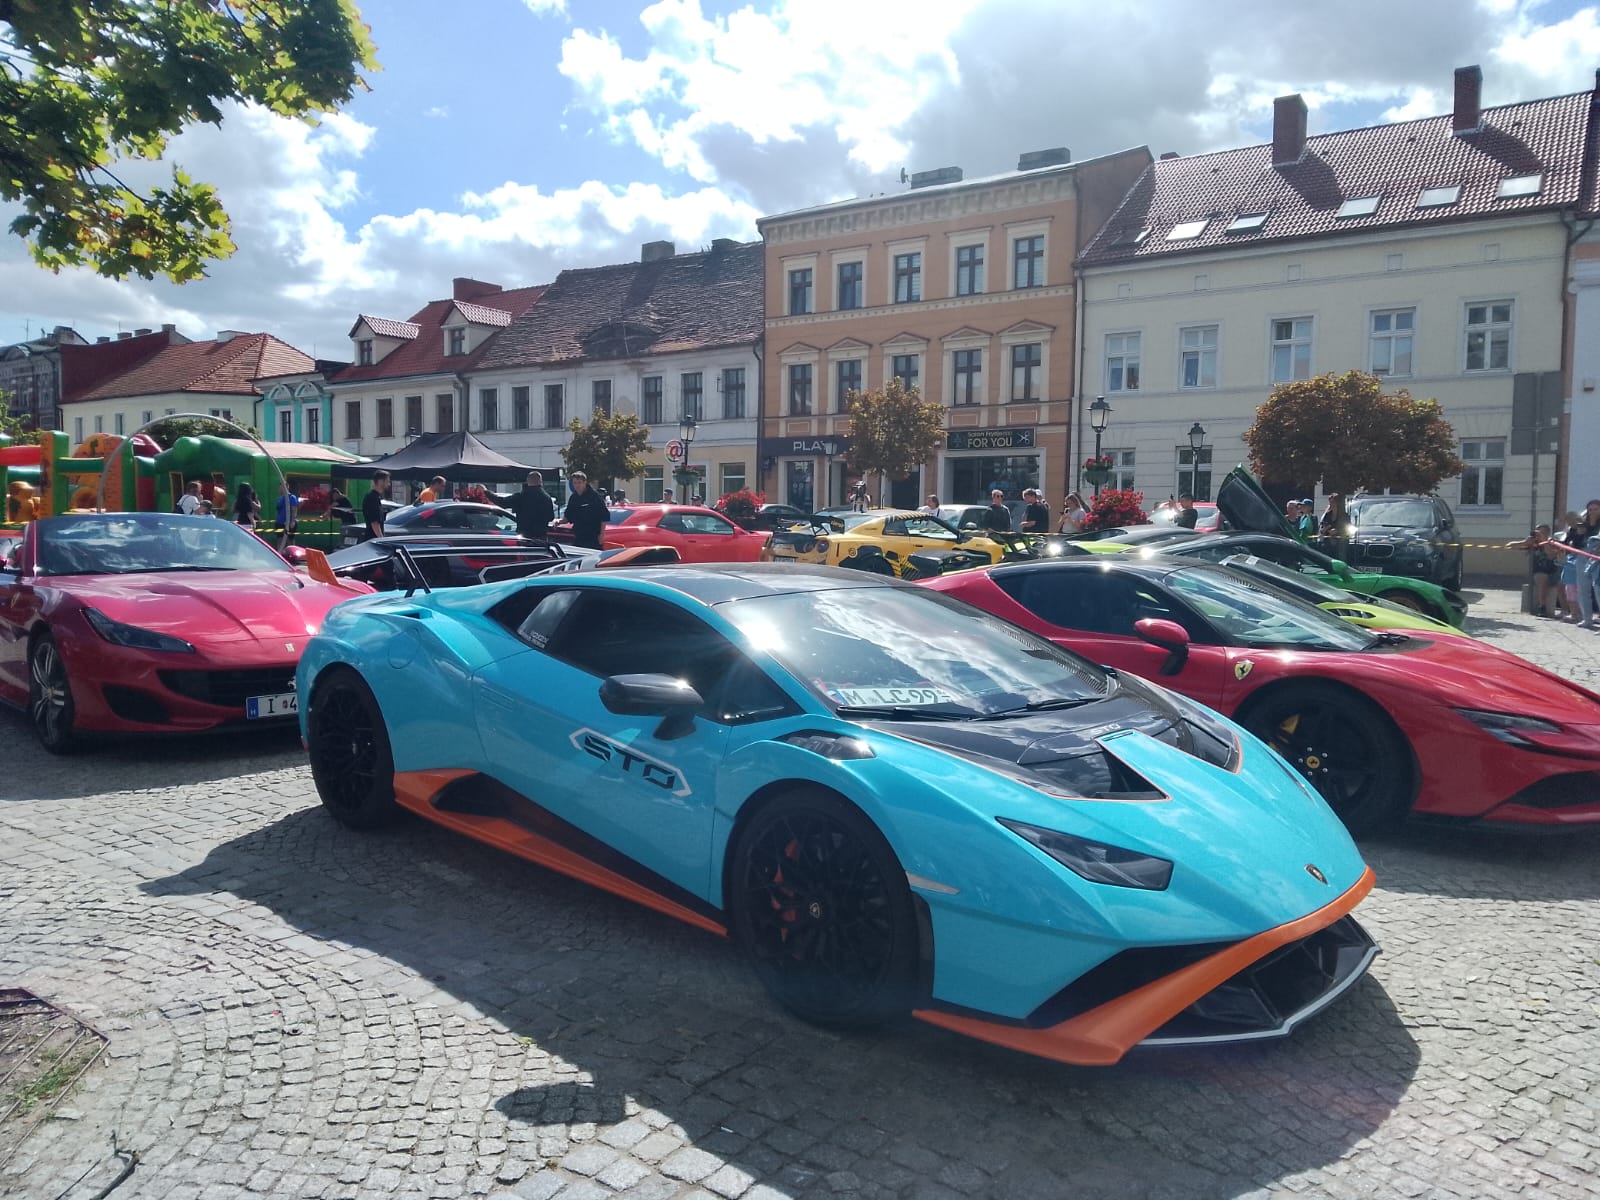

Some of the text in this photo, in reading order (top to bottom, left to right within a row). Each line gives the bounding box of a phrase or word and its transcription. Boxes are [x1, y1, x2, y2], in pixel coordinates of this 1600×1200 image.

[967, 437, 1013, 448] FOR YOU
[584, 735, 675, 789] STO
